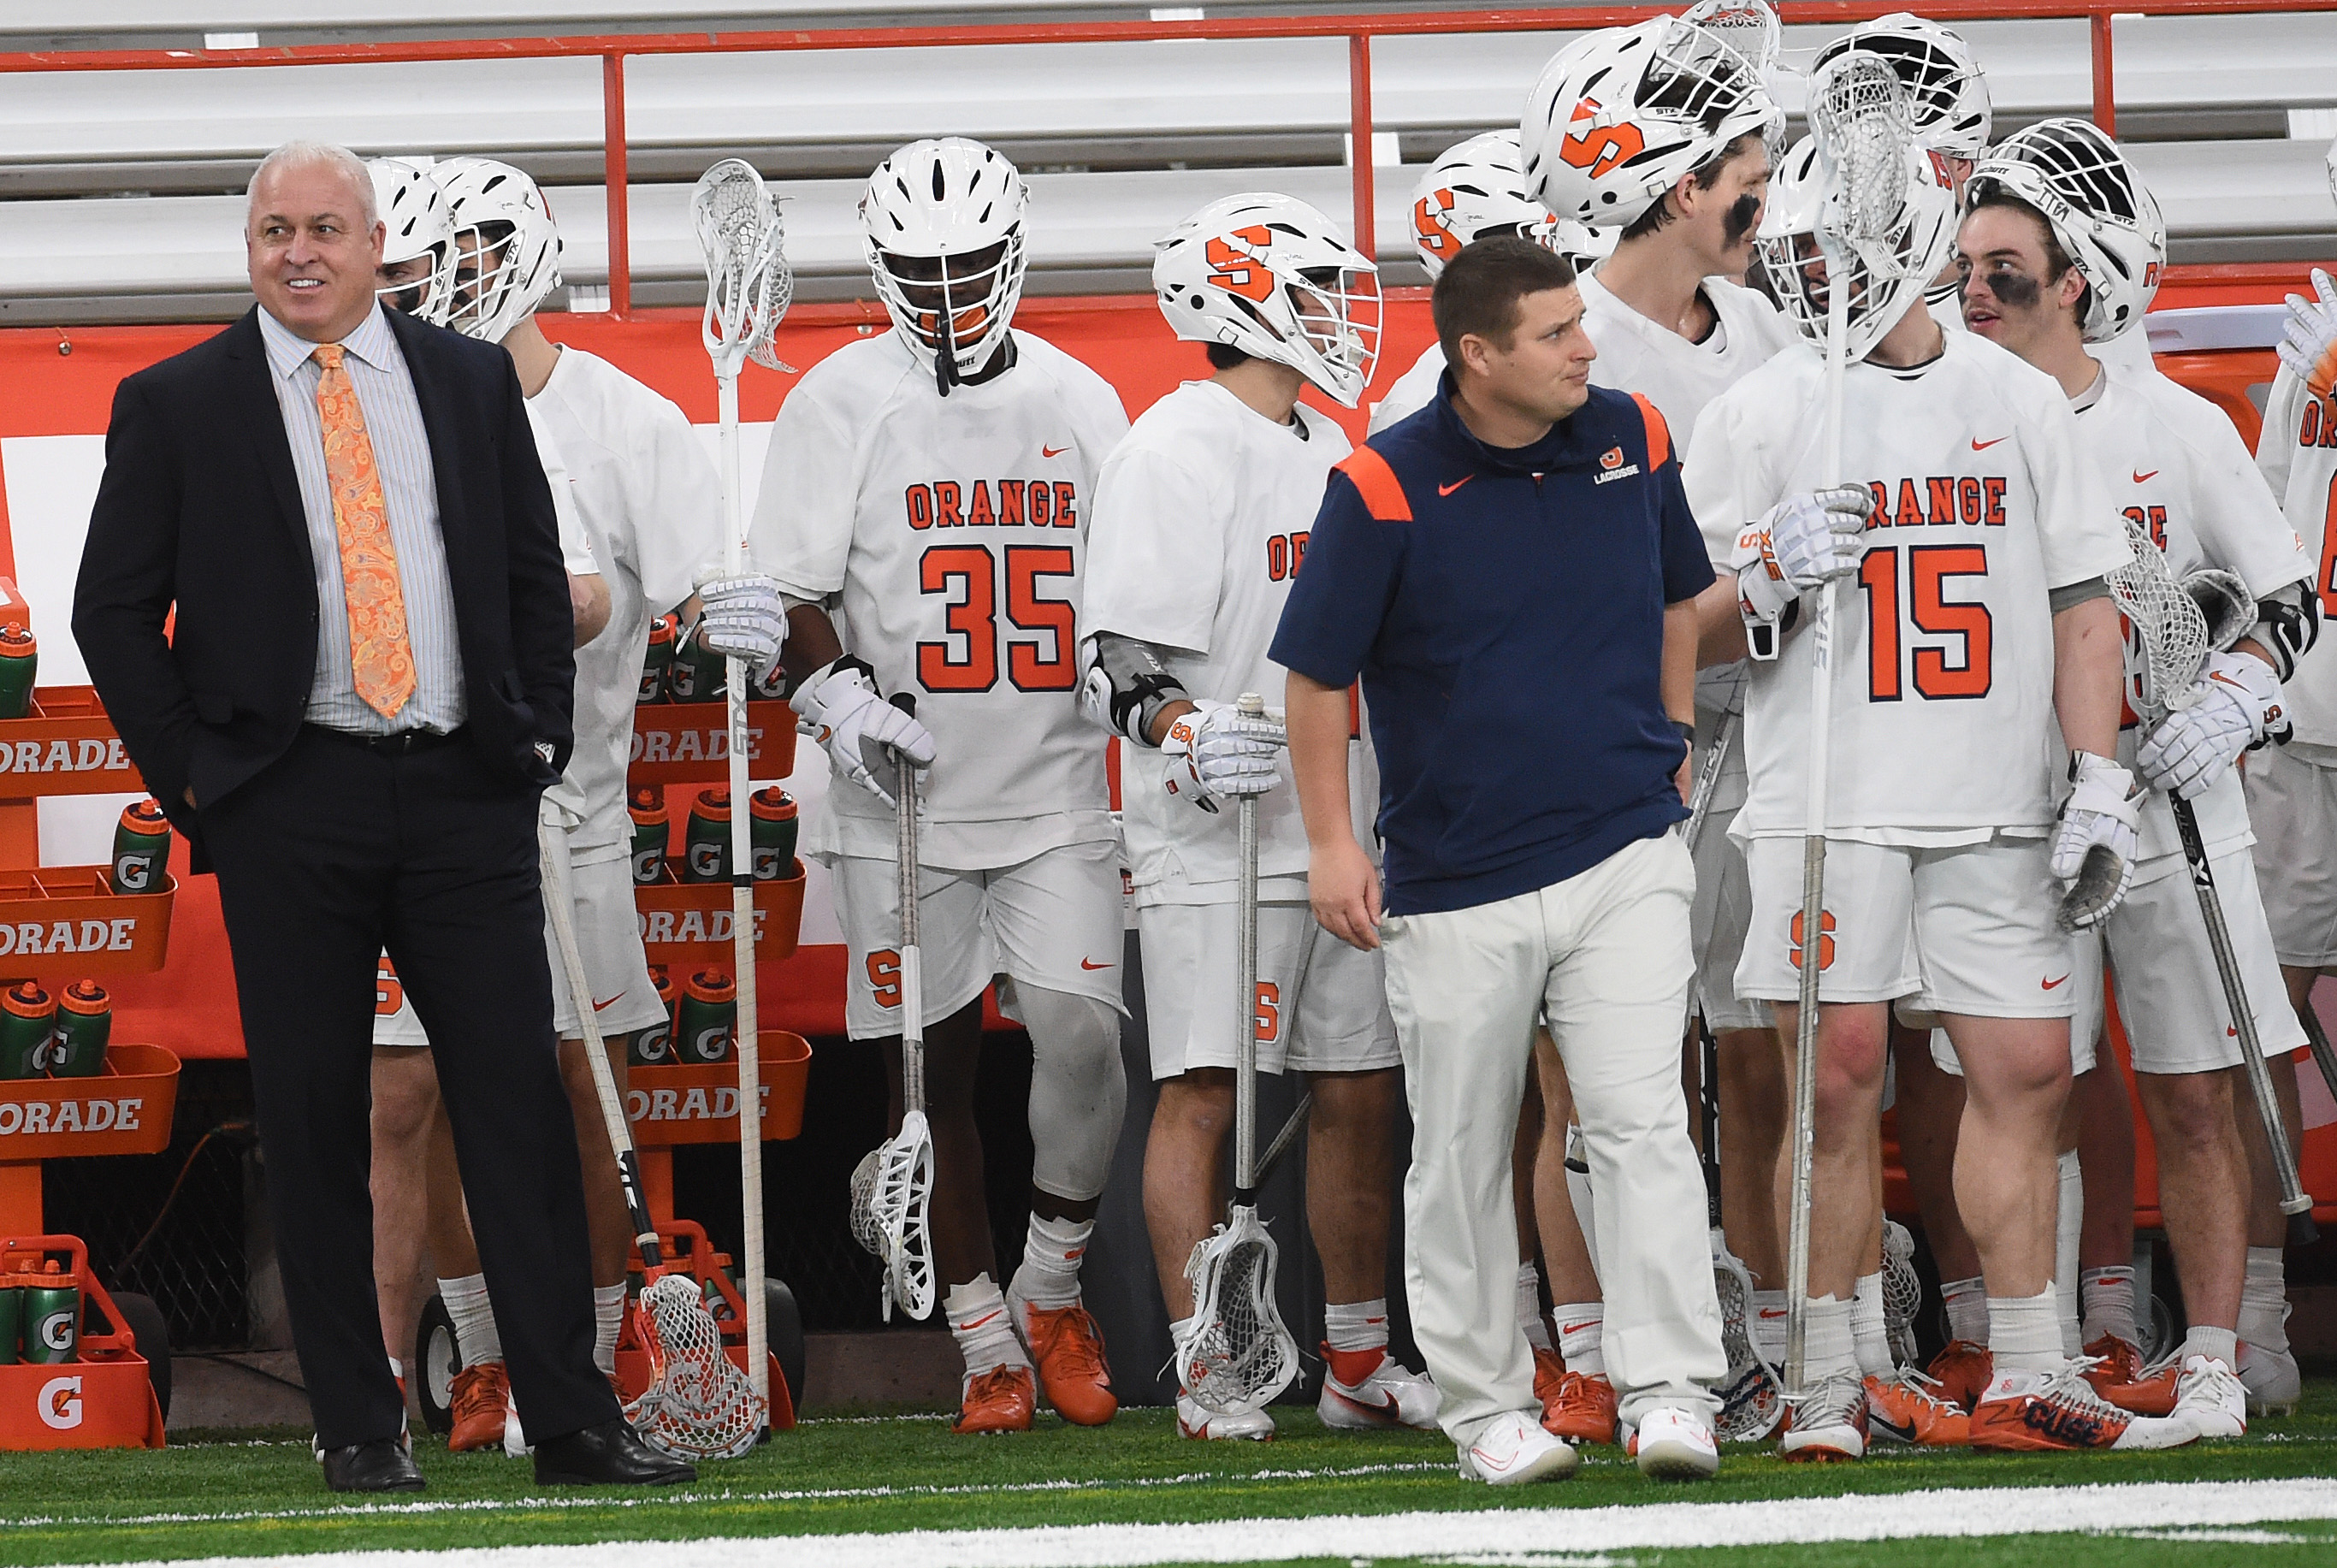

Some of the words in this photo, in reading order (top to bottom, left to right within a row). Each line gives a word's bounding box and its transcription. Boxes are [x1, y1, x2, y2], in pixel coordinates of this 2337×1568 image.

[506, 240, 519, 264] STX
[1889, 225, 1906, 246] STX
[1205, 224, 1275, 304] S
[2074, 257, 2092, 275] STX
[1594, 464, 1640, 485] LACROSSE
[905, 479, 1076, 530] ORANGE
[916, 544, 1078, 693] 35
[1857, 544, 1992, 702] 15
[732, 693, 749, 756] STX
[117, 855, 151, 889] G
[632, 847, 663, 882] G
[690, 843, 722, 877] G
[865, 948, 902, 1009] S
[638, 1027, 670, 1061] G
[696, 1027, 727, 1060] G
[43, 1312, 74, 1350] G
[38, 1376, 83, 1429] G
[2023, 1399, 2103, 1447] CUSE
